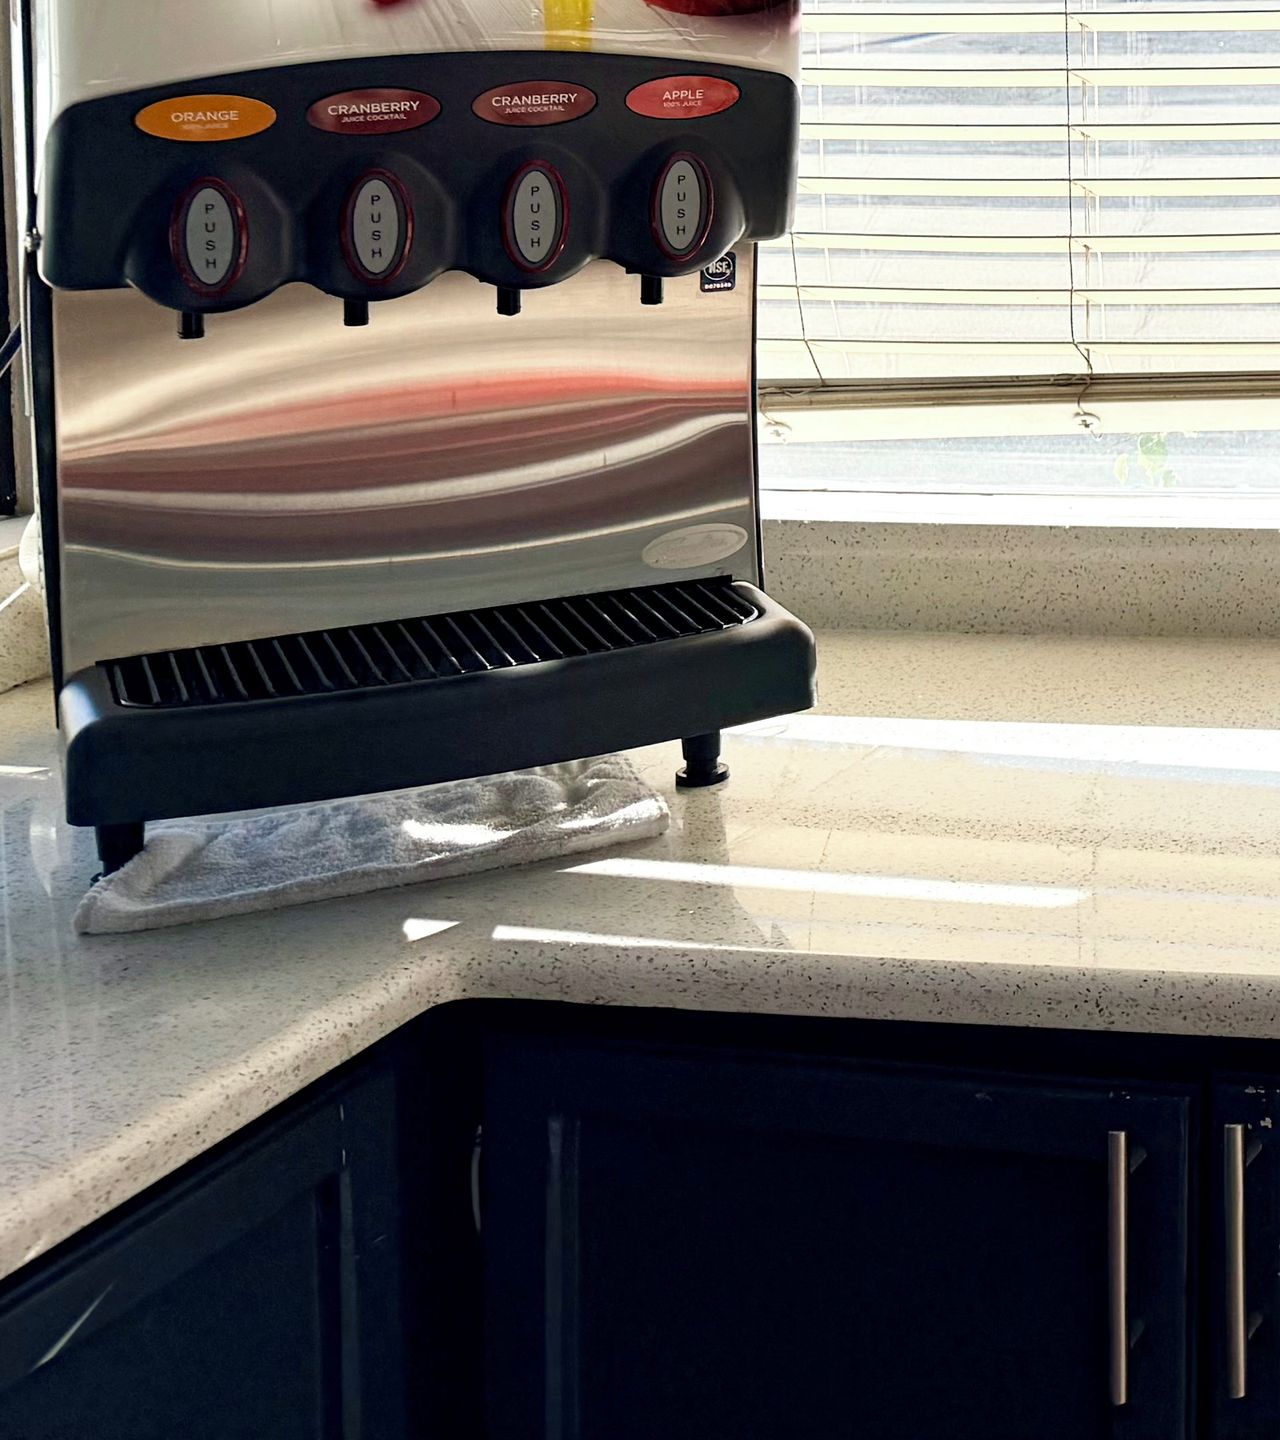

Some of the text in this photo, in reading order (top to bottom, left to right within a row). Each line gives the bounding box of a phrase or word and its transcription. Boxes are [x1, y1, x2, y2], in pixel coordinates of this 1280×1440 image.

[492, 93, 578, 107] CRANBERRY
[662, 89, 704, 100] APPLE
[327, 101, 420, 116] CRANBERRY
[505, 104, 565, 114] JUICE COCKTAIL
[171, 110, 239, 122] ORANGE
[341, 113, 407, 123] JUICE COCKTAIL
[677, 175, 687, 236] PUSH
[530, 186, 541, 248] PUSH
[370, 195, 383, 258] PUSH
[204, 203, 217, 269] PUSH
[709, 261, 729, 274] NSF
